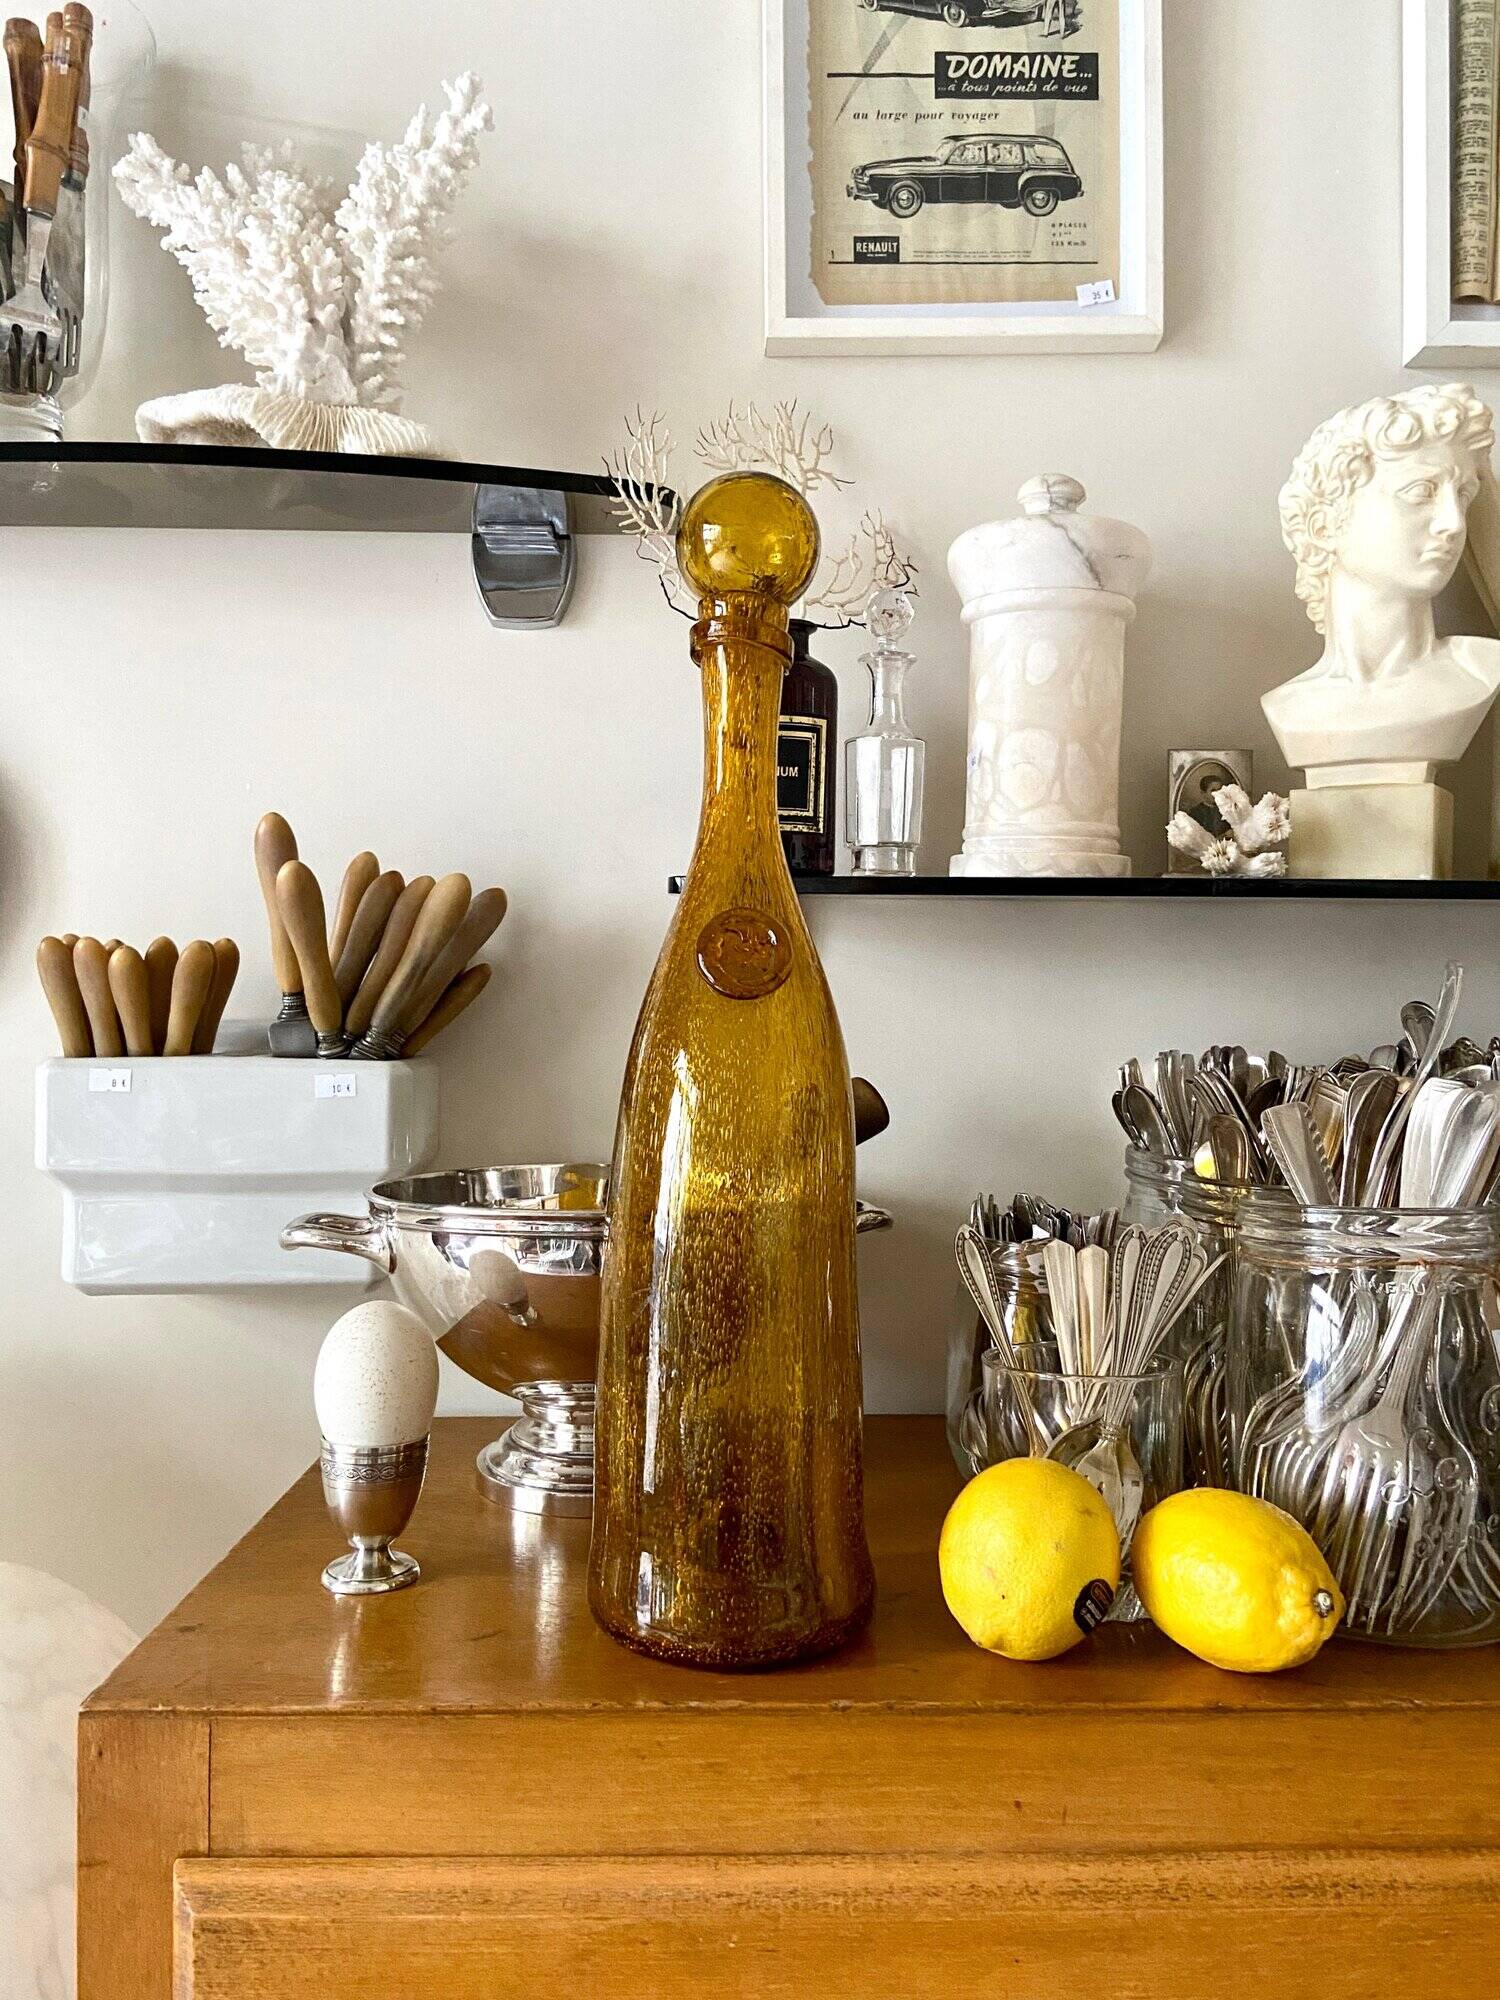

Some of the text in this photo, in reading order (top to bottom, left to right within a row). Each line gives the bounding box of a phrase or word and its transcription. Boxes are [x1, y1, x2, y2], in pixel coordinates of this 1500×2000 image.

[945, 54, 1092, 79] DOMAINE...
[961, 80, 989, 92] tous
[991, 81, 1037, 97] points
[1042, 80, 1059, 92] de
[1064, 84, 1088, 92] vue
[853, 109, 1000, 124] au large pour voyager
[856, 241, 898, 254] RENAULT
[111, 1078, 117, 1088] 8
[332, 1084, 342, 1094] 10
